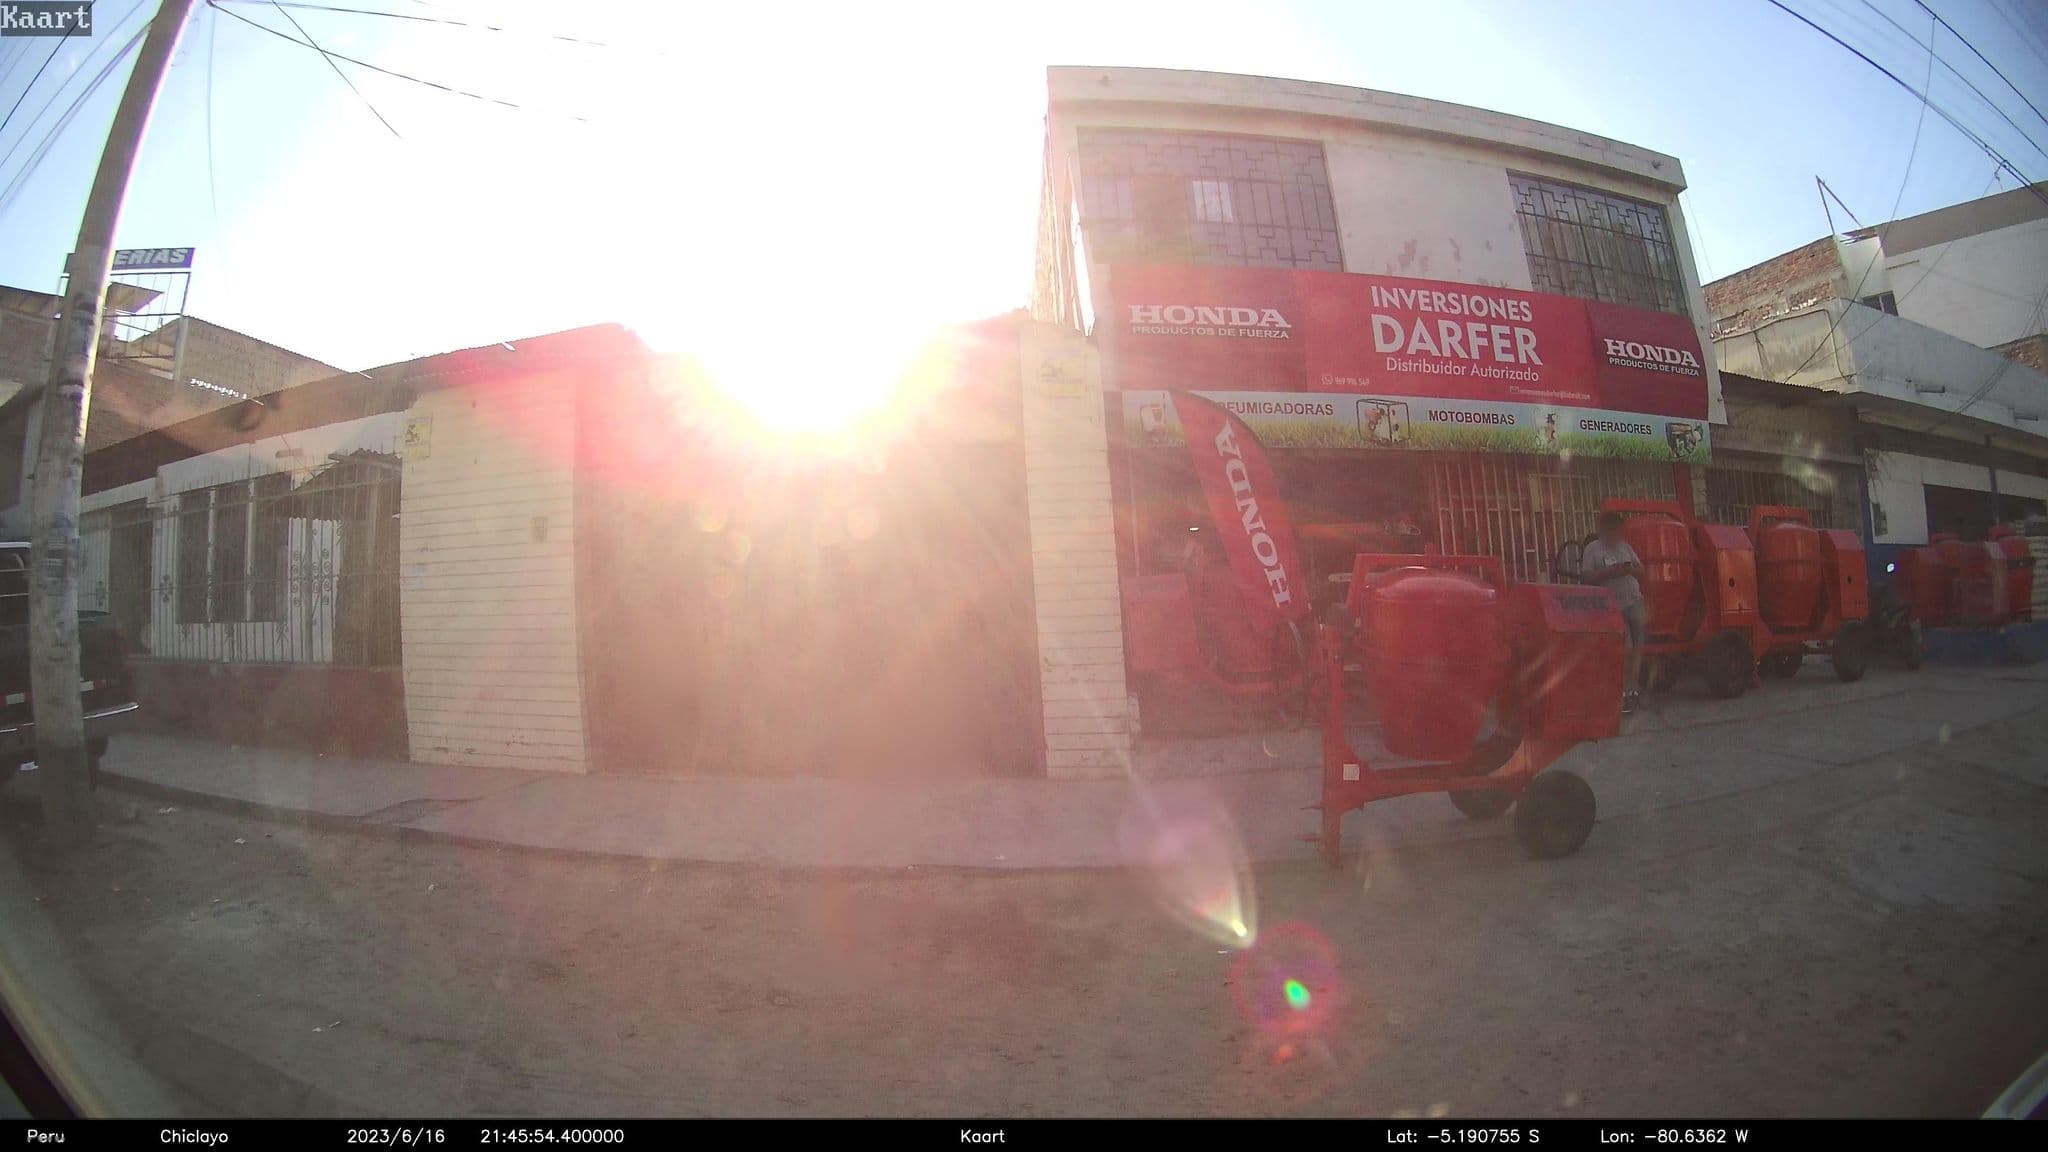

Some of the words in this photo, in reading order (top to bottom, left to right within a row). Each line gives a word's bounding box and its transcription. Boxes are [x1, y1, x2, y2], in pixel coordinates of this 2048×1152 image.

[1128, 304, 1292, 329] HONDA
[1371, 285, 1533, 323] INVERSIONES
[1132, 325, 1216, 337] PRODUCTOS
[1218, 328, 1236, 337] DE
[1239, 328, 1290, 340] FUERZA
[1371, 313, 1543, 366] DARFER
[1604, 338, 1700, 369] HONDA
[1386, 356, 1467, 377] Distribuidor
[1470, 363, 1539, 382] Autorizado
[1609, 356, 1659, 371] PRODUCTOS
[1659, 364, 1671, 372] DE
[1671, 366, 1700, 377] FUERZA
[1428, 409, 1515, 426] MOTOBOMBAS
[1579, 418, 1652, 436] GENERADORES
[1215, 418, 1291, 608] HONDA
